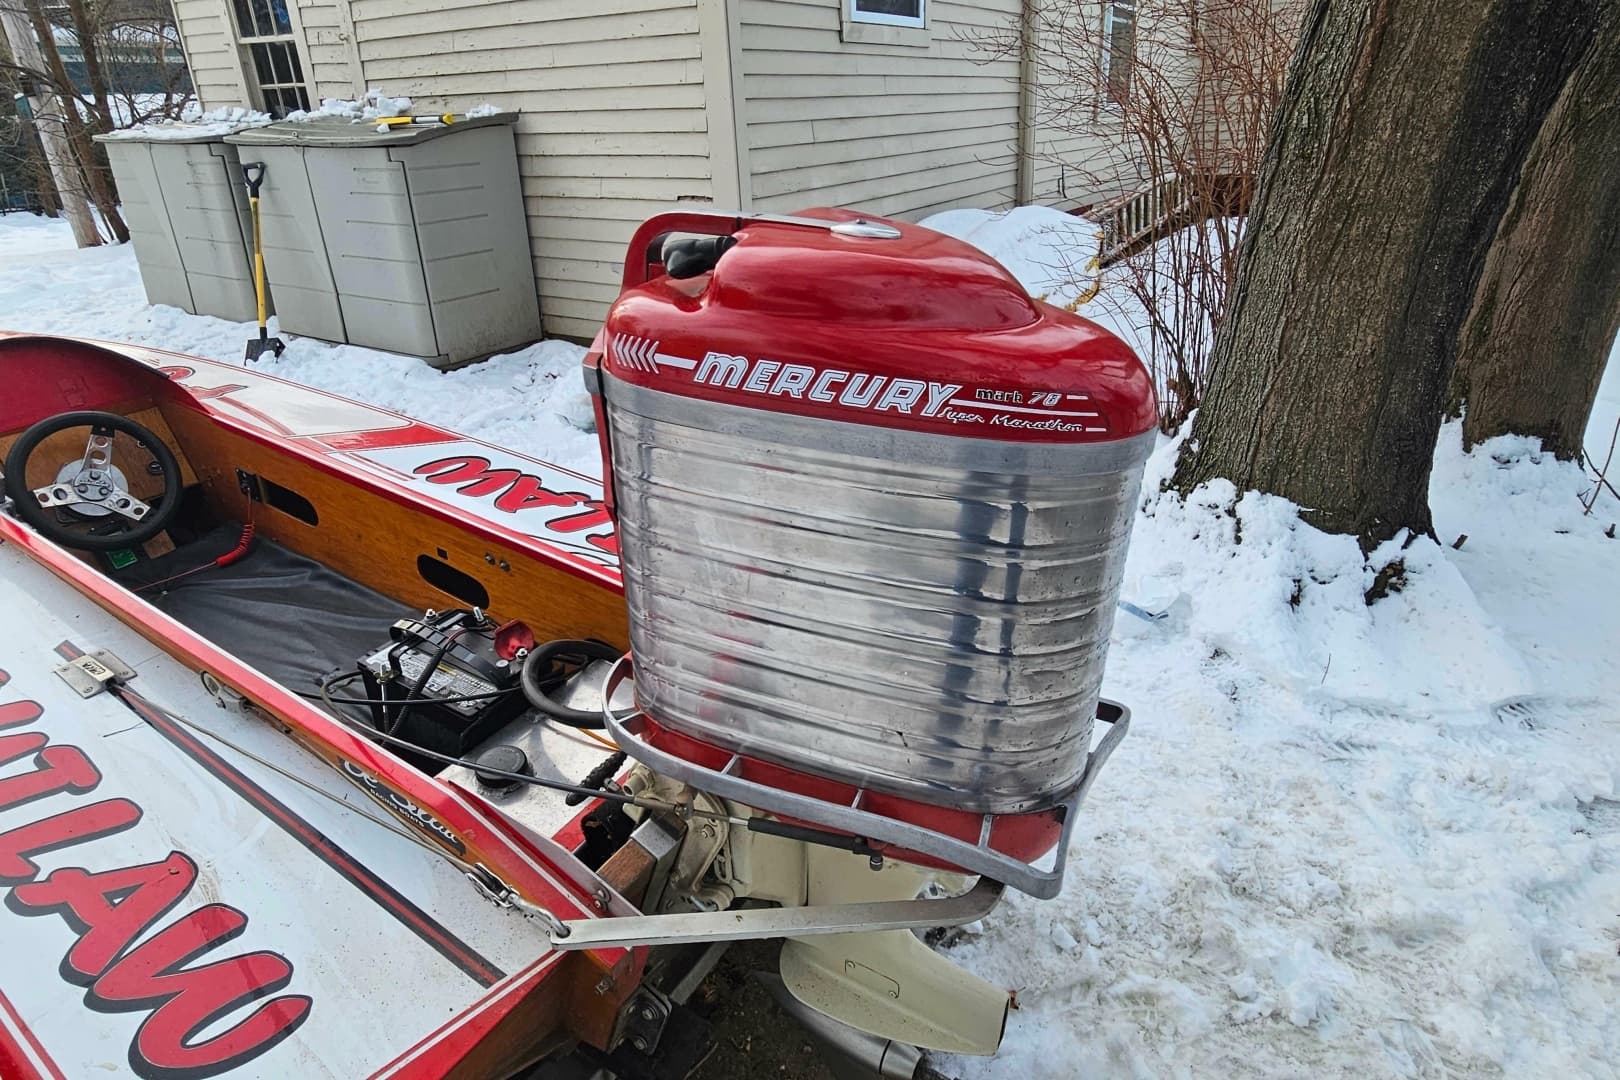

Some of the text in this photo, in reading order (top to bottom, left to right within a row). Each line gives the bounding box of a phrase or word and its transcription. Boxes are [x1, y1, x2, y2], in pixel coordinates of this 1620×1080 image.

[693, 352, 963, 416] MERCURY
[976, 388, 1062, 407] mark 78
